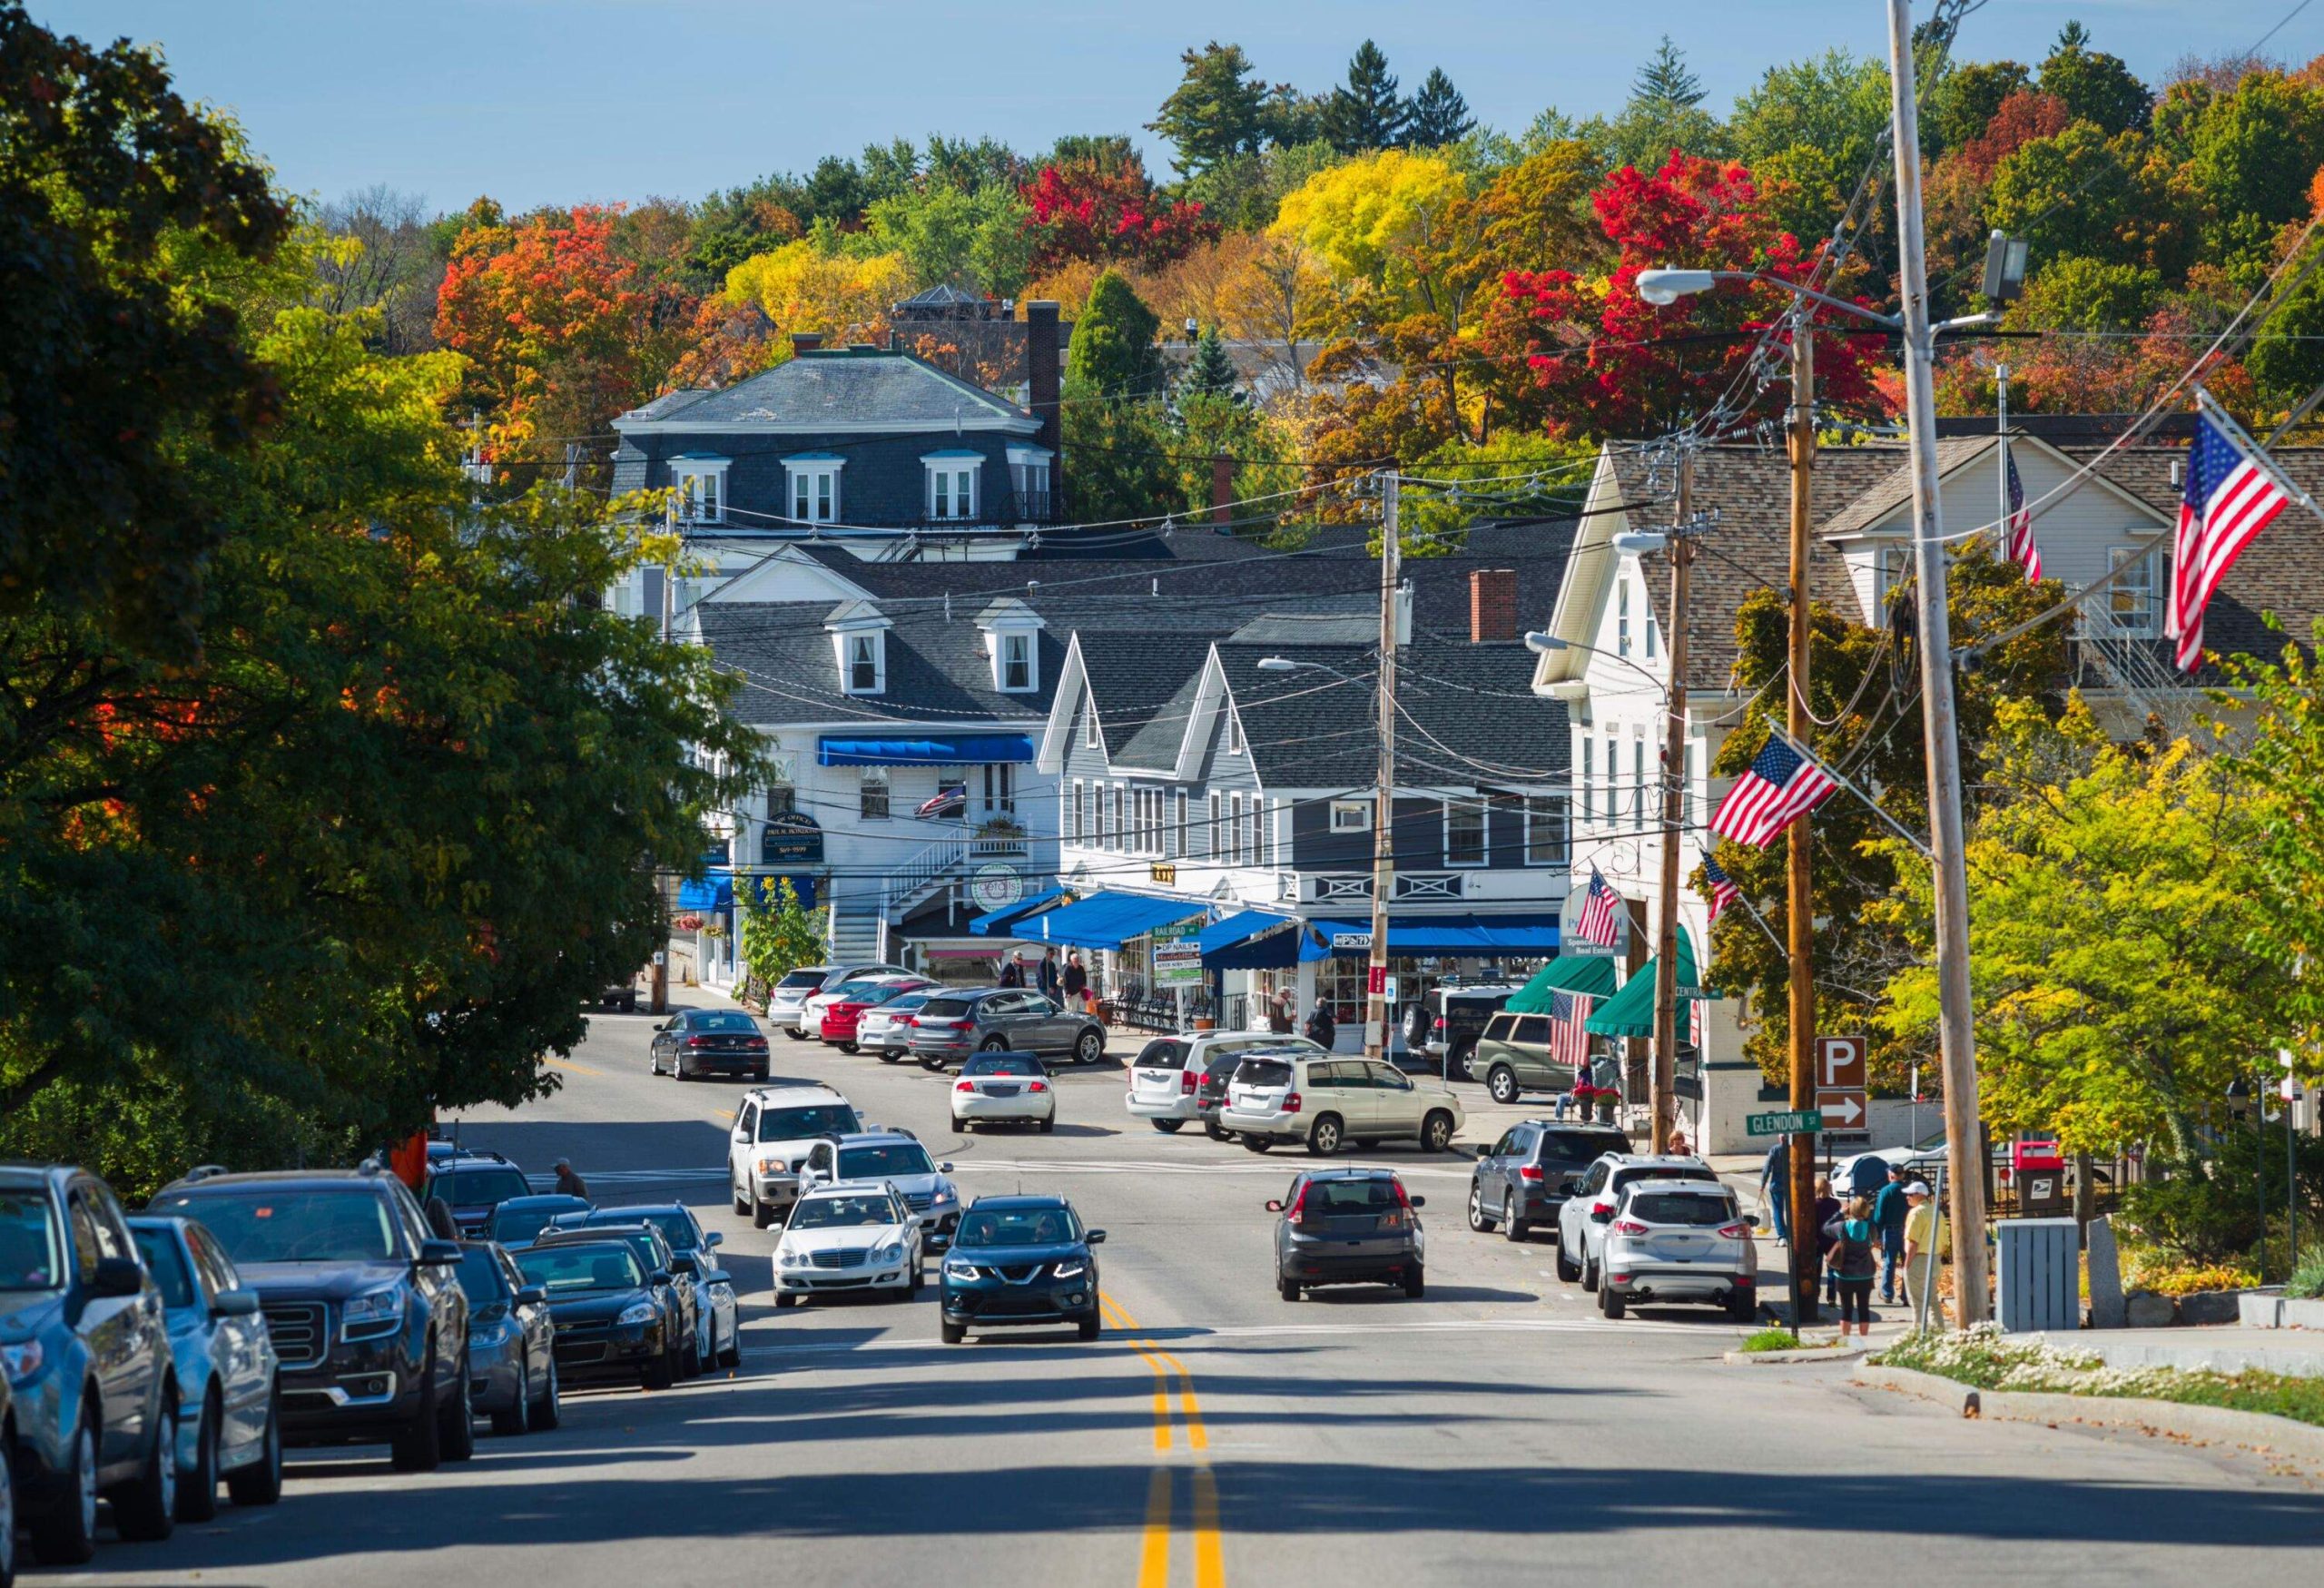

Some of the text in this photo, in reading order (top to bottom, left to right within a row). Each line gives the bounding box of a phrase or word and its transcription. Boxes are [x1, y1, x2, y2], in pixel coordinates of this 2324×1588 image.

[1155, 926, 1186, 936] RAILROAD
[1827, 1041, 1856, 1085] P
[1752, 1114, 1817, 1133] GLENDON ST
